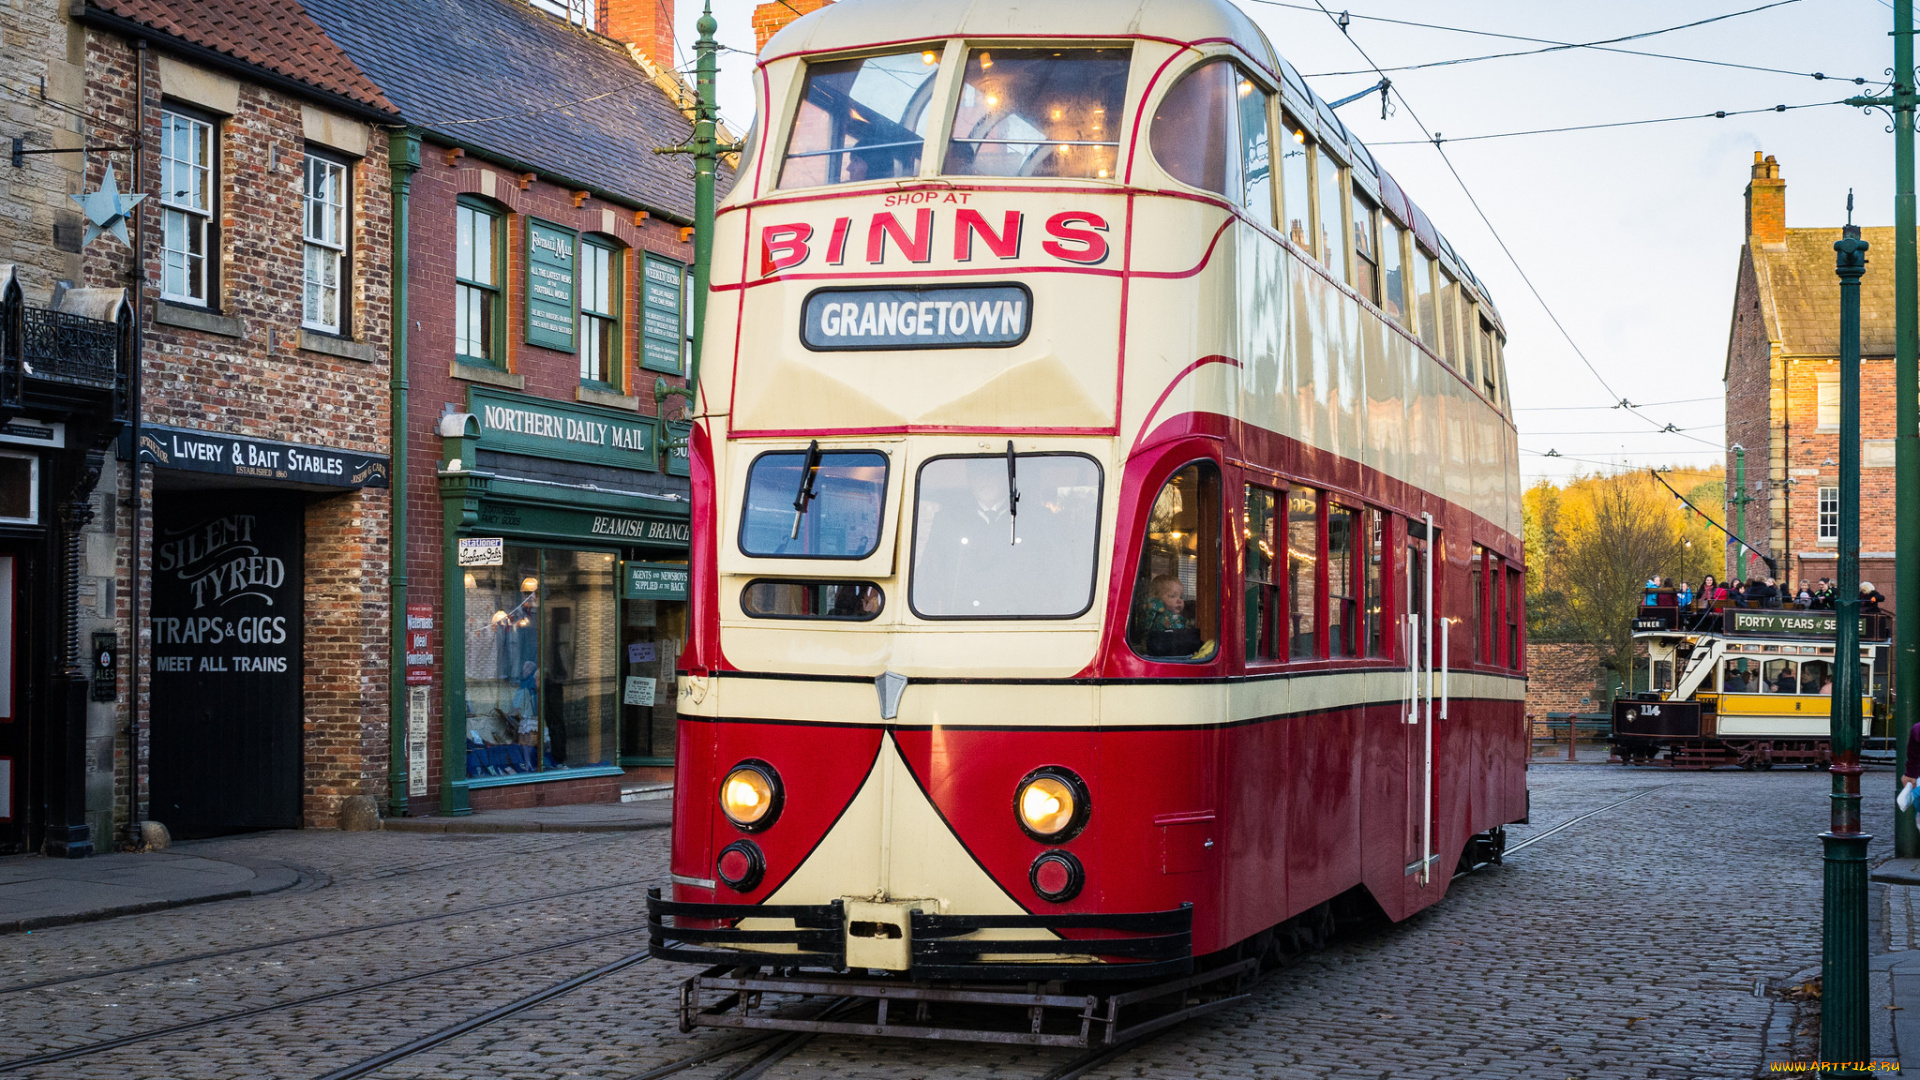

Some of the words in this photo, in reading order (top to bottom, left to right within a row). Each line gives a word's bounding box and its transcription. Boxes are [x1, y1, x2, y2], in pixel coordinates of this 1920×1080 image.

[884, 191, 938, 206] SHOP
[943, 192, 972, 204] AT
[554, 238, 573, 259] MAIL
[761, 207, 1110, 278] BINNS
[538, 268, 546, 277] THE
[547, 271, 560, 281] LATEST
[561, 275, 571, 284] NEWS
[645, 267, 666, 281] WEEKLY
[667, 274, 680, 285] ECHO
[534, 285, 554, 296] FOOTBALL
[555, 290, 568, 300] WORLD
[820, 301, 1023, 337] GRANGETOWN
[484, 405, 564, 439] NORTHERN
[566, 418, 608, 445] DAILY
[612, 425, 644, 451] MAIL
[140, 436, 170, 464] PRIETOR
[173, 435, 223, 462] LIVERY
[232, 442, 244, 465] &
[248, 444, 280, 469] BAIT
[288, 449, 343, 475] STABLES
[236, 466, 272, 476] ESTABLISHED
[372, 462, 387, 479] CARR
[502, 516, 521, 526] GOODS
[591, 516, 644, 537] BEAMISH
[648, 522, 690, 541] BRANCH
[159, 514, 255, 571] SILENT
[190, 556, 285, 610] TYRED
[633, 570, 651, 579] AGENTS
[661, 572, 687, 581] NEWSBOYS
[635, 581, 658, 590] SUPPLIED
[671, 582, 684, 591] BACK
[152, 616, 224, 644] TRAPS
[225, 622, 235, 637] &
[237, 616, 286, 644] GIGS
[1739, 616, 1775, 628] FORTY
[1779, 618, 1814, 629] YEARS
[157, 656, 193, 672] MEET
[199, 656, 228, 672] ALL
[232, 656, 288, 673] TRAINS
[1641, 705, 1661, 716] 114
